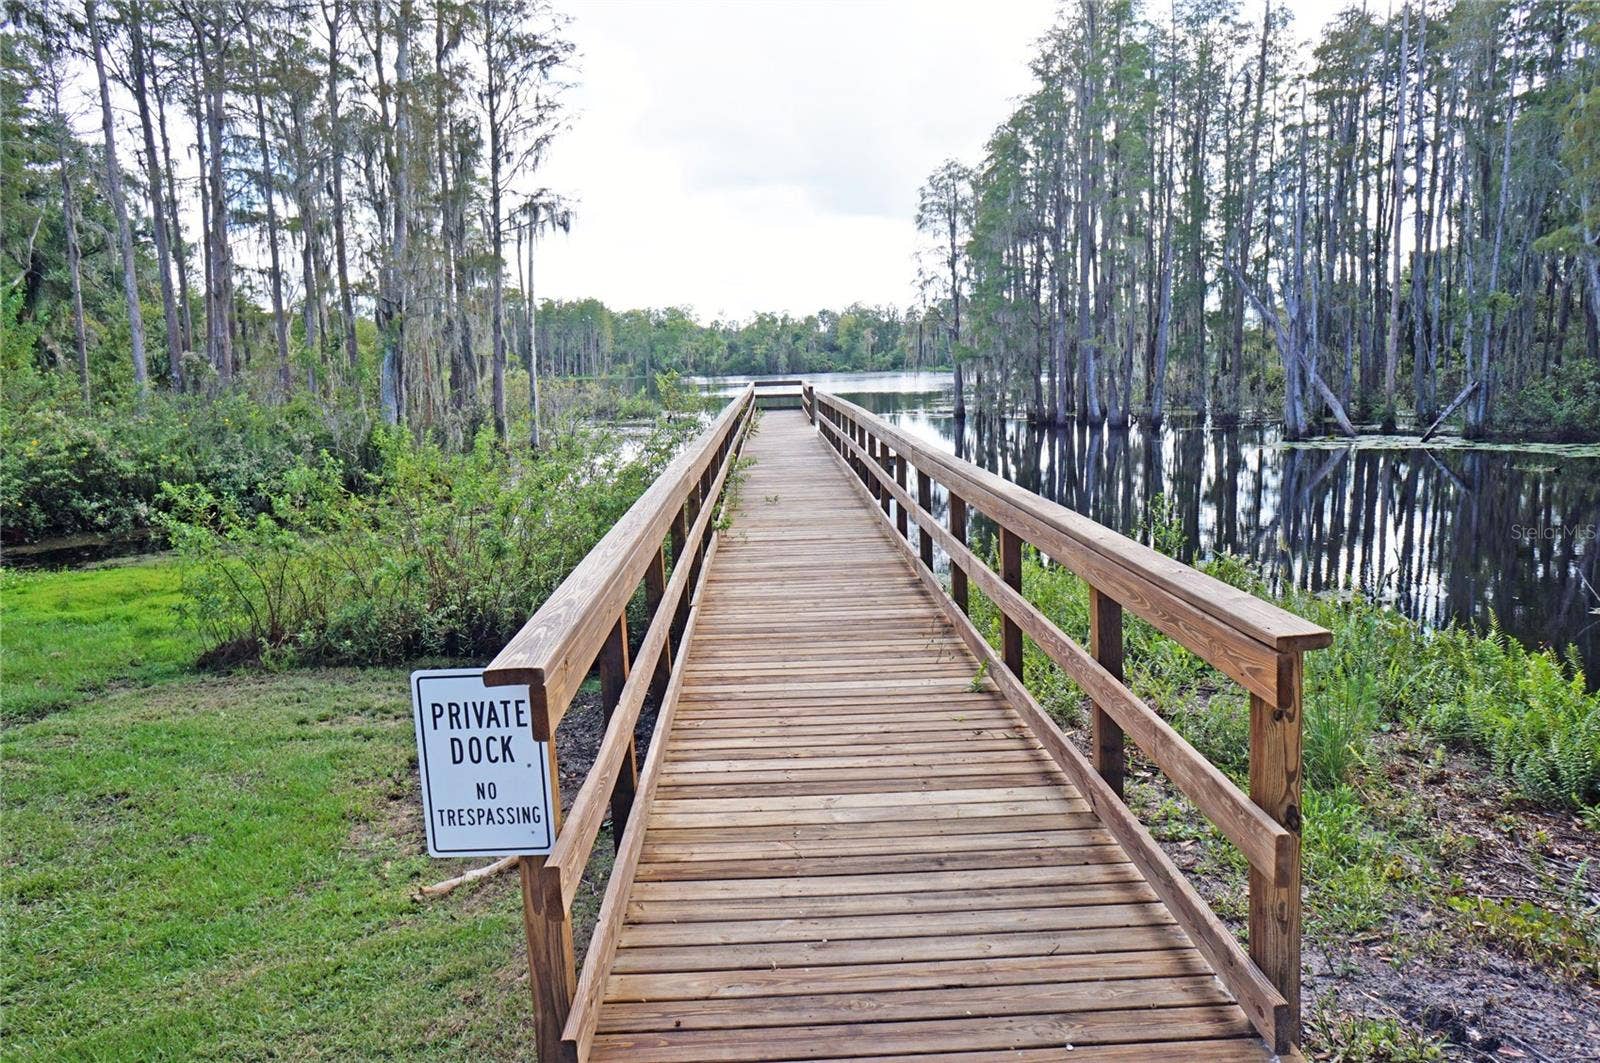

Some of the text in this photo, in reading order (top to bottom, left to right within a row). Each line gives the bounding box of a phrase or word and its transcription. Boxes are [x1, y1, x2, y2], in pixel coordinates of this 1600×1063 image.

[431, 700, 528, 730] PRIVATE
[450, 735, 515, 765] DOCK
[476, 782, 497, 800] NO
[438, 806, 541, 827] TRESPASSING
